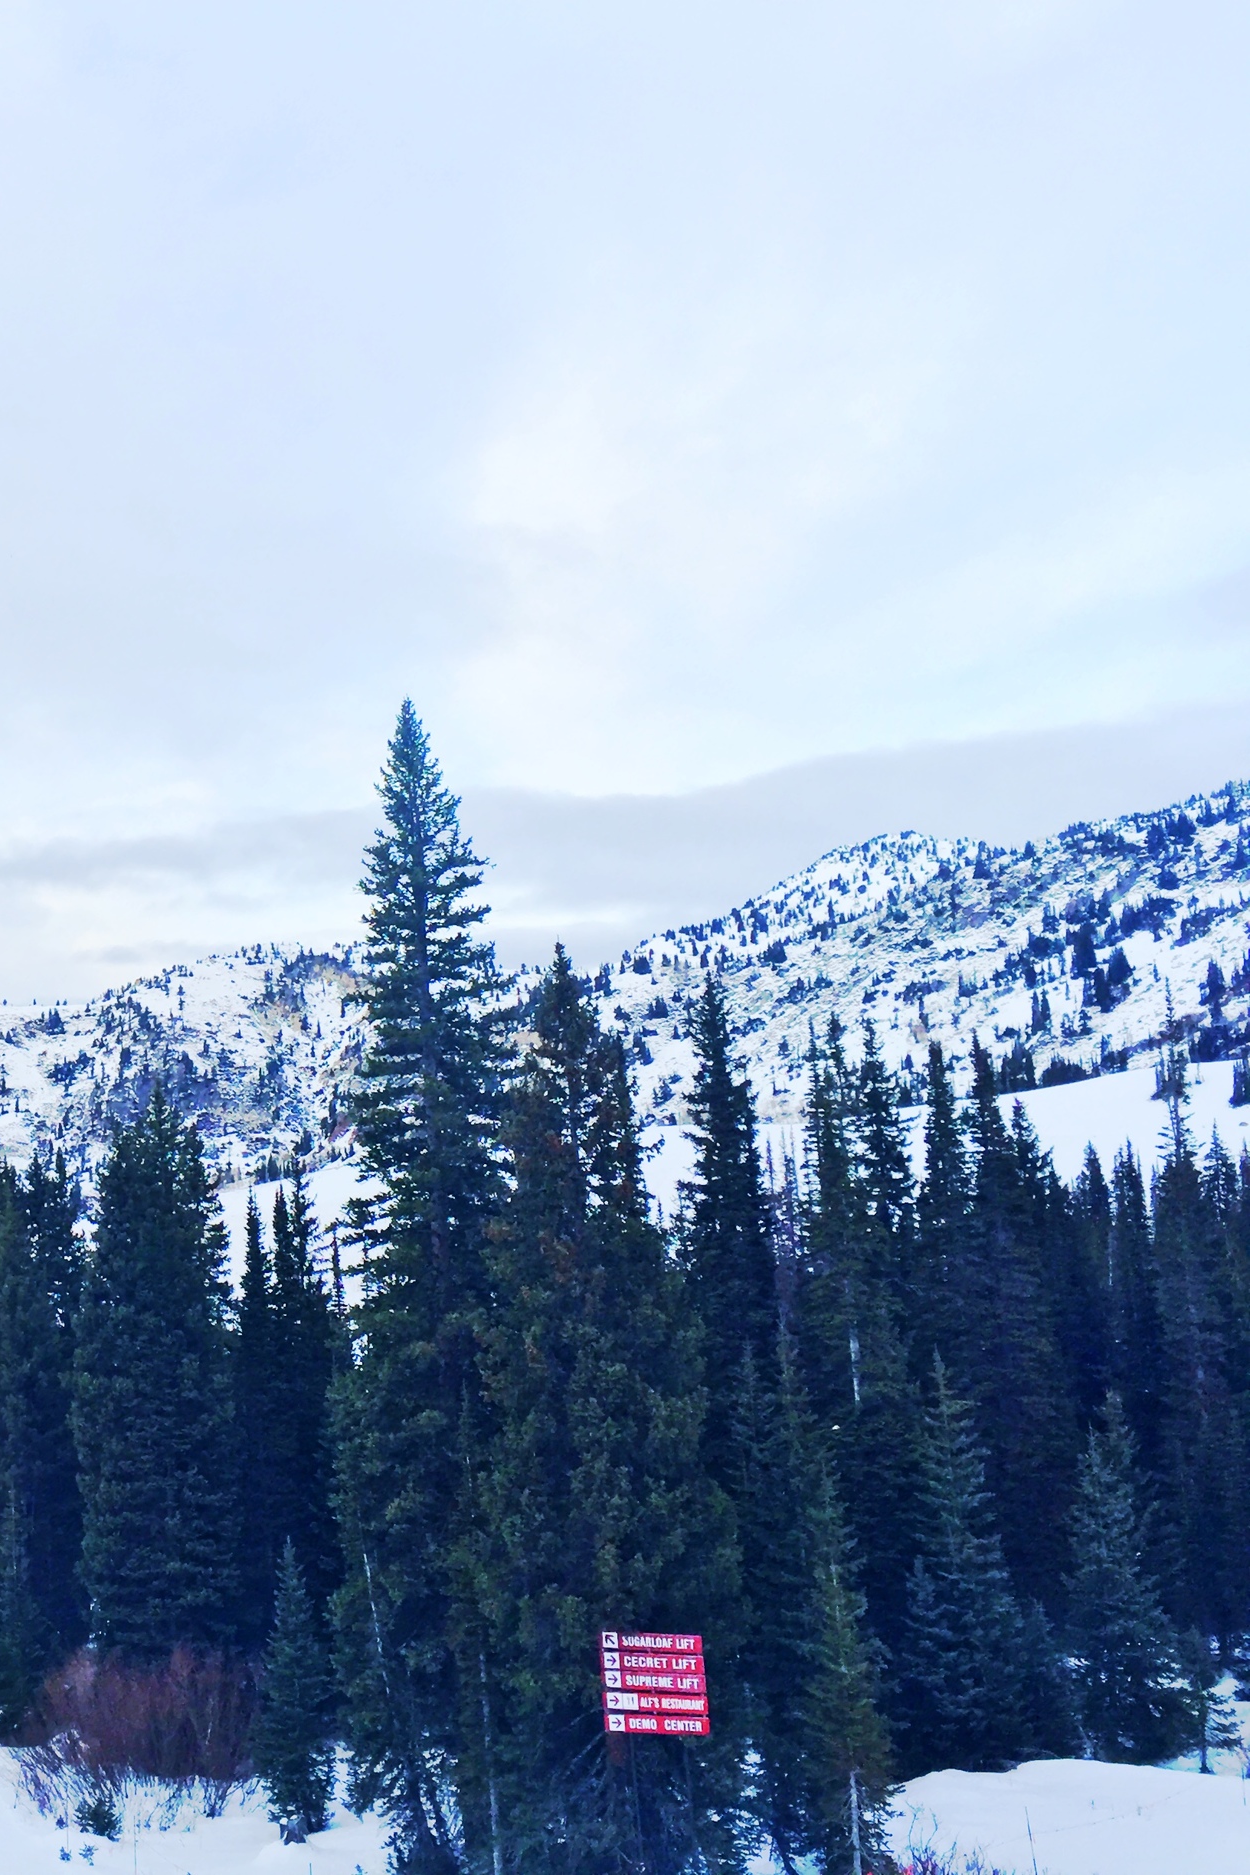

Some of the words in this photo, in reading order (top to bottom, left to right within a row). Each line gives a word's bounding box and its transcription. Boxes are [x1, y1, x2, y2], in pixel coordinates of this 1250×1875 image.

[622, 1636, 673, 1648] SUGARLOAF
[676, 1639, 695, 1650] LIFT
[624, 1656, 668, 1669] CECRET
[672, 1658, 696, 1670] LIFT
[625, 1675, 674, 1688] SUPREME
[677, 1678, 699, 1689] LIFT
[661, 1698, 704, 1711] RESTAURANT
[629, 1718, 657, 1730] DEMO
[664, 1720, 702, 1732] CENTER
